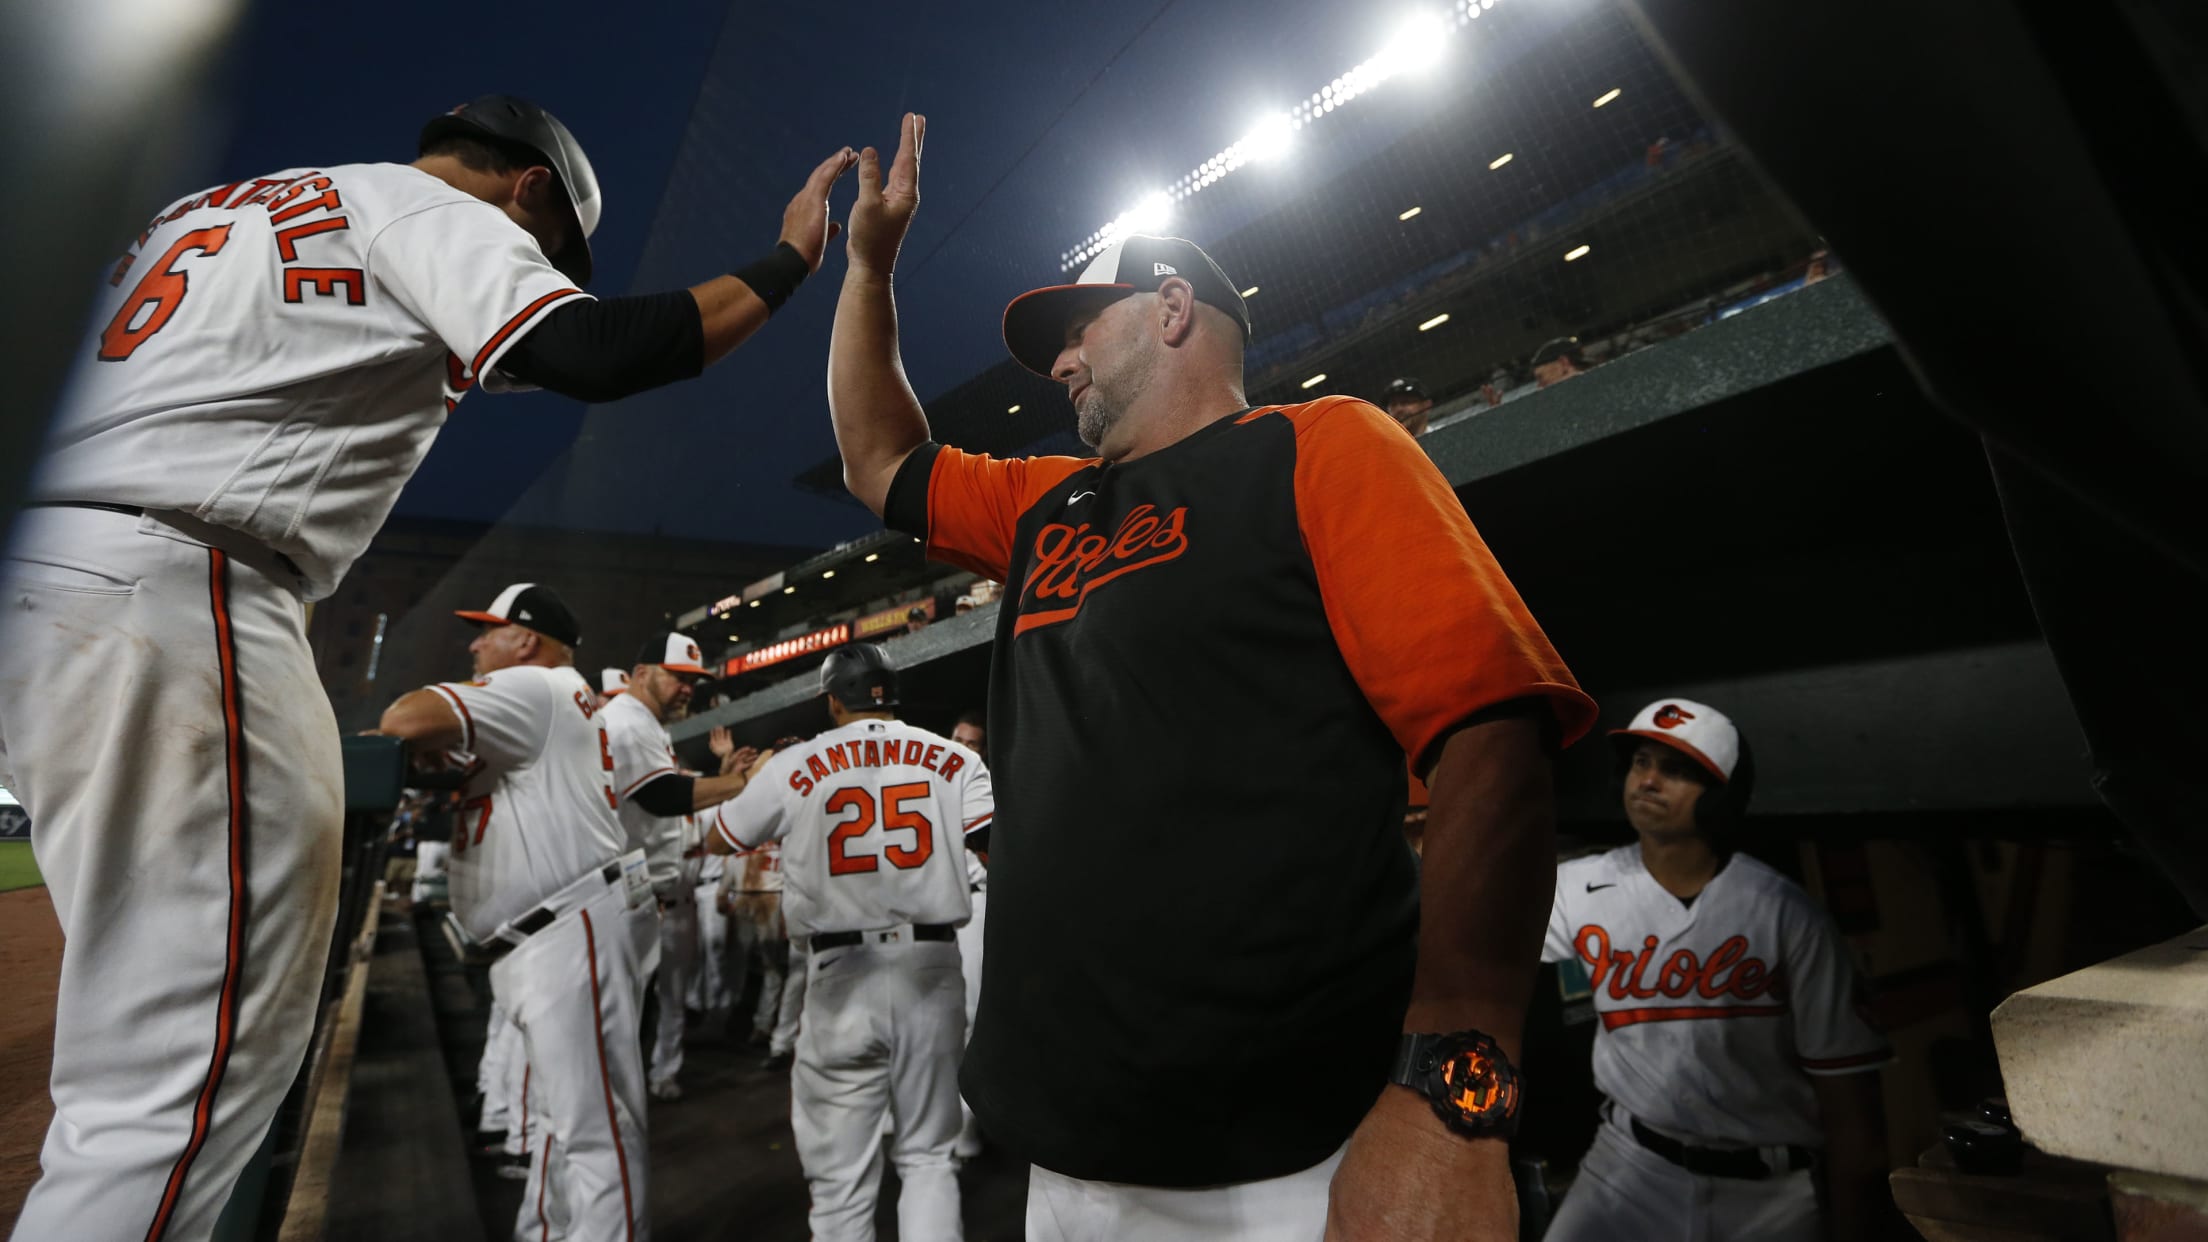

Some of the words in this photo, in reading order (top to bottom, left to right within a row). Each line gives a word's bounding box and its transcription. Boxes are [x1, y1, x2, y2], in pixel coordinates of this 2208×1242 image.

[99, 221, 235, 361] 6
[789, 739, 965, 797] SANTANDER
[825, 781, 934, 877] 25
